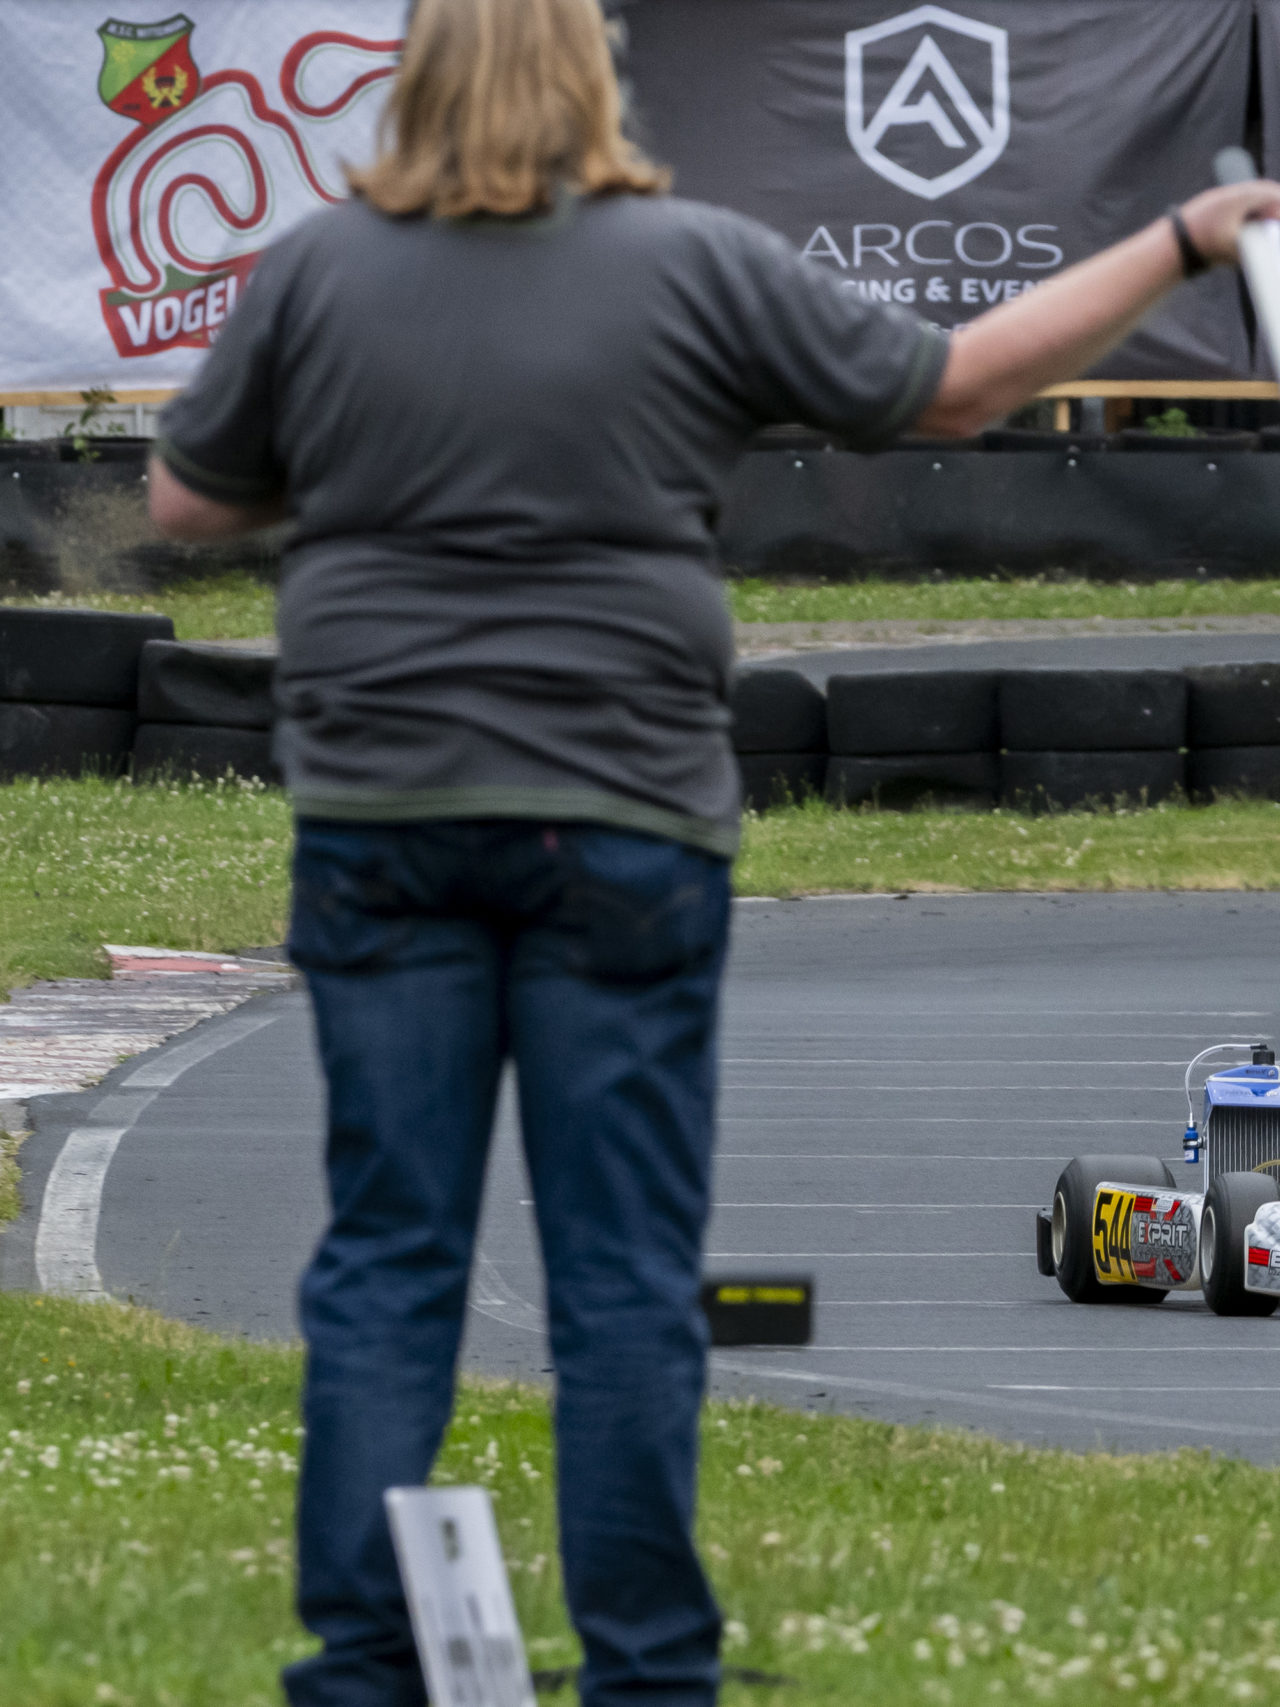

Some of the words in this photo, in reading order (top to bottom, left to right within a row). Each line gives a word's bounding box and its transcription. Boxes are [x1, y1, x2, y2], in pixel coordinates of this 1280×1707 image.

[801, 219, 1065, 268] ARCOS
[925, 276, 951, 303] &
[1094, 1191, 1136, 1281] 544
[1138, 1221, 1189, 1248] EXPRIT
